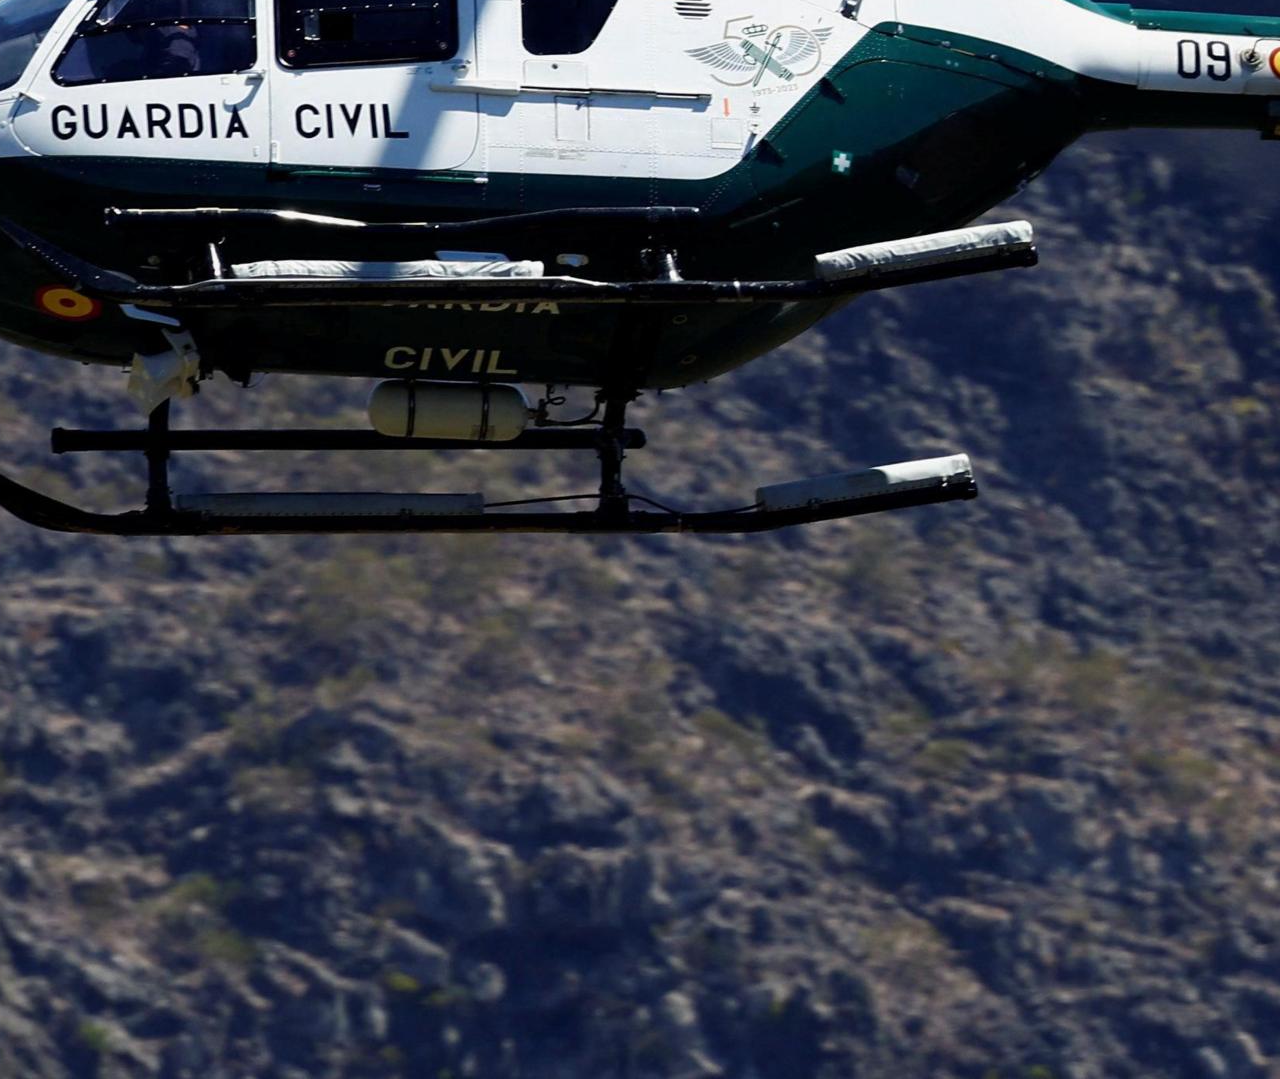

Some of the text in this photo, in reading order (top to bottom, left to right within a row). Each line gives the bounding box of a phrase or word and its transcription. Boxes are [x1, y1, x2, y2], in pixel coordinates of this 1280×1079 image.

[1177, 39, 1232, 82] 09
[51, 103, 410, 140] GUARDIA CIVIL
[383, 346, 518, 375] CIVIL
